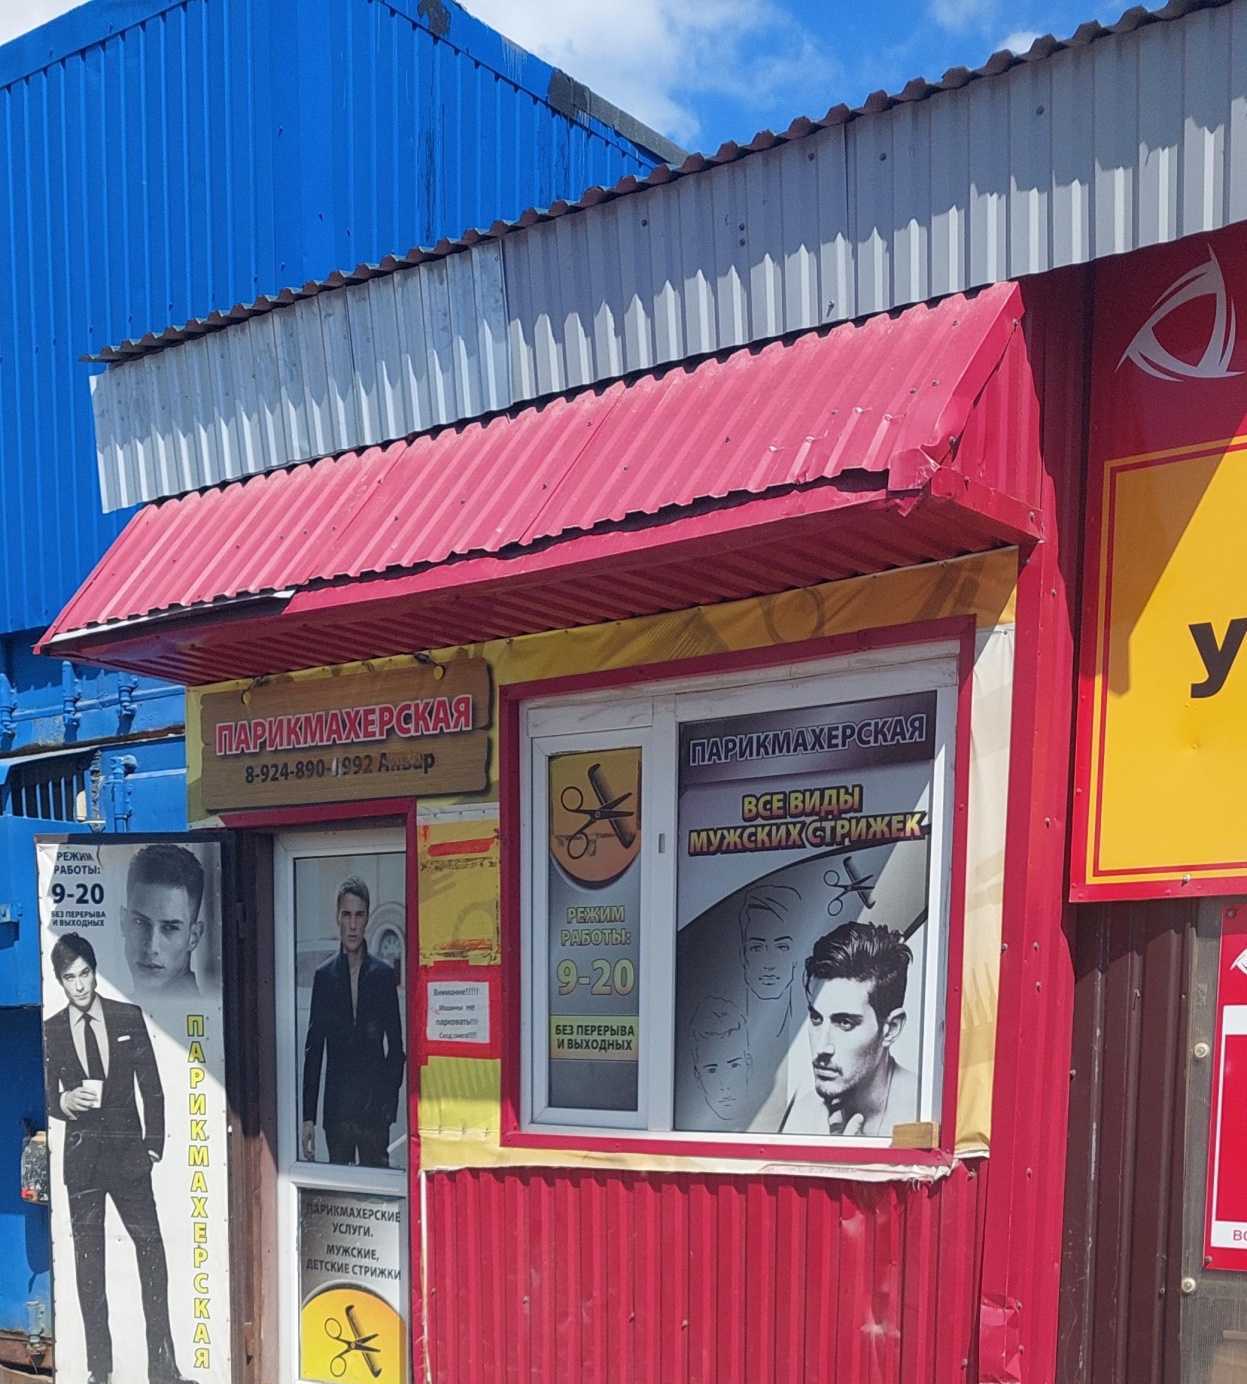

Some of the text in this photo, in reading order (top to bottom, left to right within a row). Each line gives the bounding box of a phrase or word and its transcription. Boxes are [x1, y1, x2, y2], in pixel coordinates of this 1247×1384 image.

[215, 694, 473, 756] ПАРИКМАХЕРСКАЯ
[690, 714, 927, 766] ПАРИКМАХЕРСКАЯ
[742, 784, 863, 822] ВСЕ ВИДЫ
[688, 811, 927, 856] МУЖСКИХ СТРИЖЕК
[57, 851, 95, 861] РЕЖИМ
[54, 865, 101, 875] РАБОТЫ:
[51, 883, 105, 905] 9-20
[51, 910, 106, 918] БЕЗ ПЕРЕРЫВА
[53, 919, 105, 928] И ВЫХОДНЫХ
[567, 905, 625, 924] РЕЖИМ
[560, 928, 632, 947] РАБОТЫ:
[556, 958, 635, 996] 9-20
[555, 1024, 635, 1036] БЕЗ ПЕРЕРЫВА
[557, 1038, 632, 1052] И ВЫХОДНЫХ
[187, 1014, 211, 1369] ПАРИКМАХЕРСКАЯ
[306, 1203, 401, 1223] ПАРИКМАХЕРСКИЕ
[332, 1222, 374, 1238] УСЛУГИ.
[326, 1244, 379, 1262] МУЖСКИЕ,
[306, 1259, 402, 1281] ДЕТСКИЕ СТРИЖКИ
